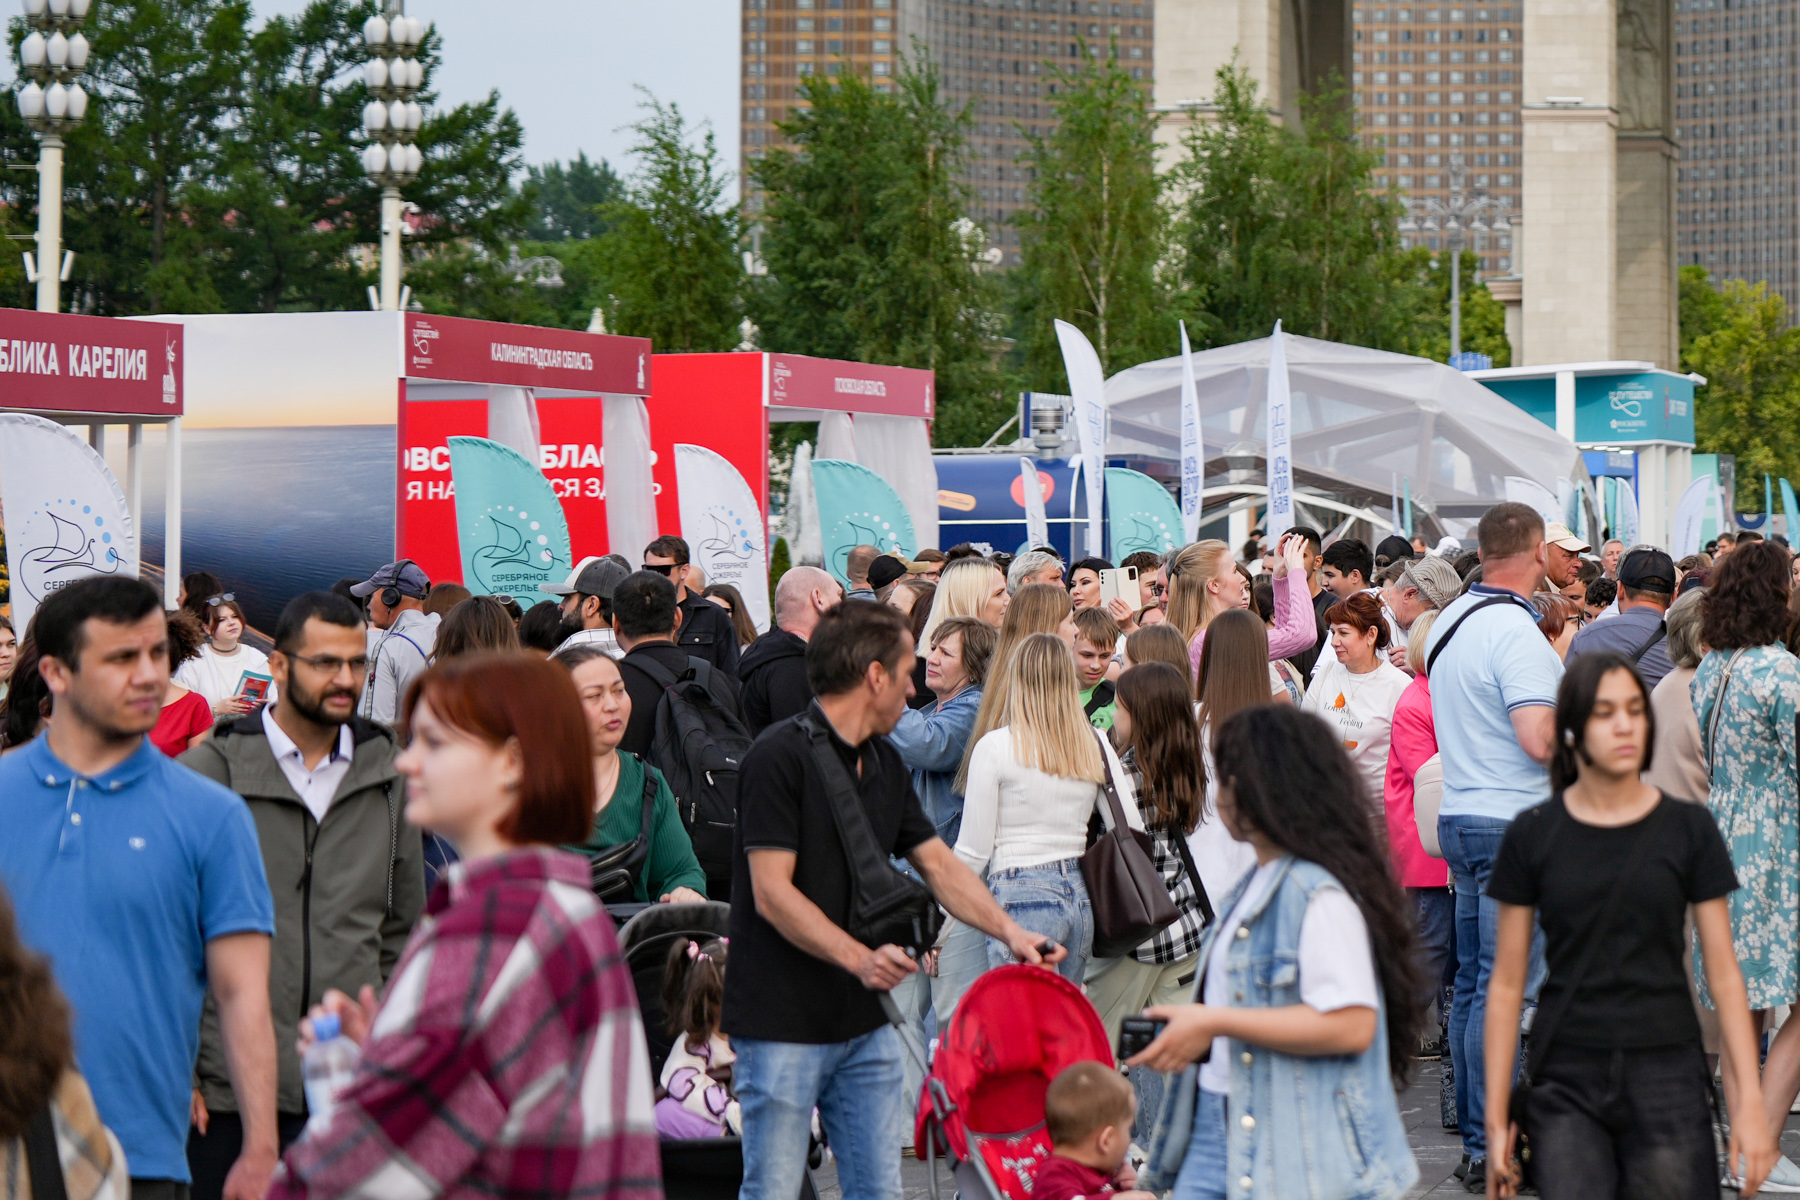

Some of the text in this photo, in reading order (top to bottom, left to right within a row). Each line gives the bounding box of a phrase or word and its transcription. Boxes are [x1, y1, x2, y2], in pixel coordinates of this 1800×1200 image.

[0, 338, 147, 381] БЛИКА КАРЕЛИЯ
[491, 342, 593, 371] КАЛИНИНГРАДСКАЯ ОБЛАСТЬ
[712, 561, 750, 570] СЕРЕБРЯНОЕ
[492, 573, 549, 583] СЕРЕБРЯНОЕ
[713, 571, 743, 579] ОЖЕРЕЛЬЕ
[493, 584, 538, 593] ОЖЕРЕЛЬЕ
